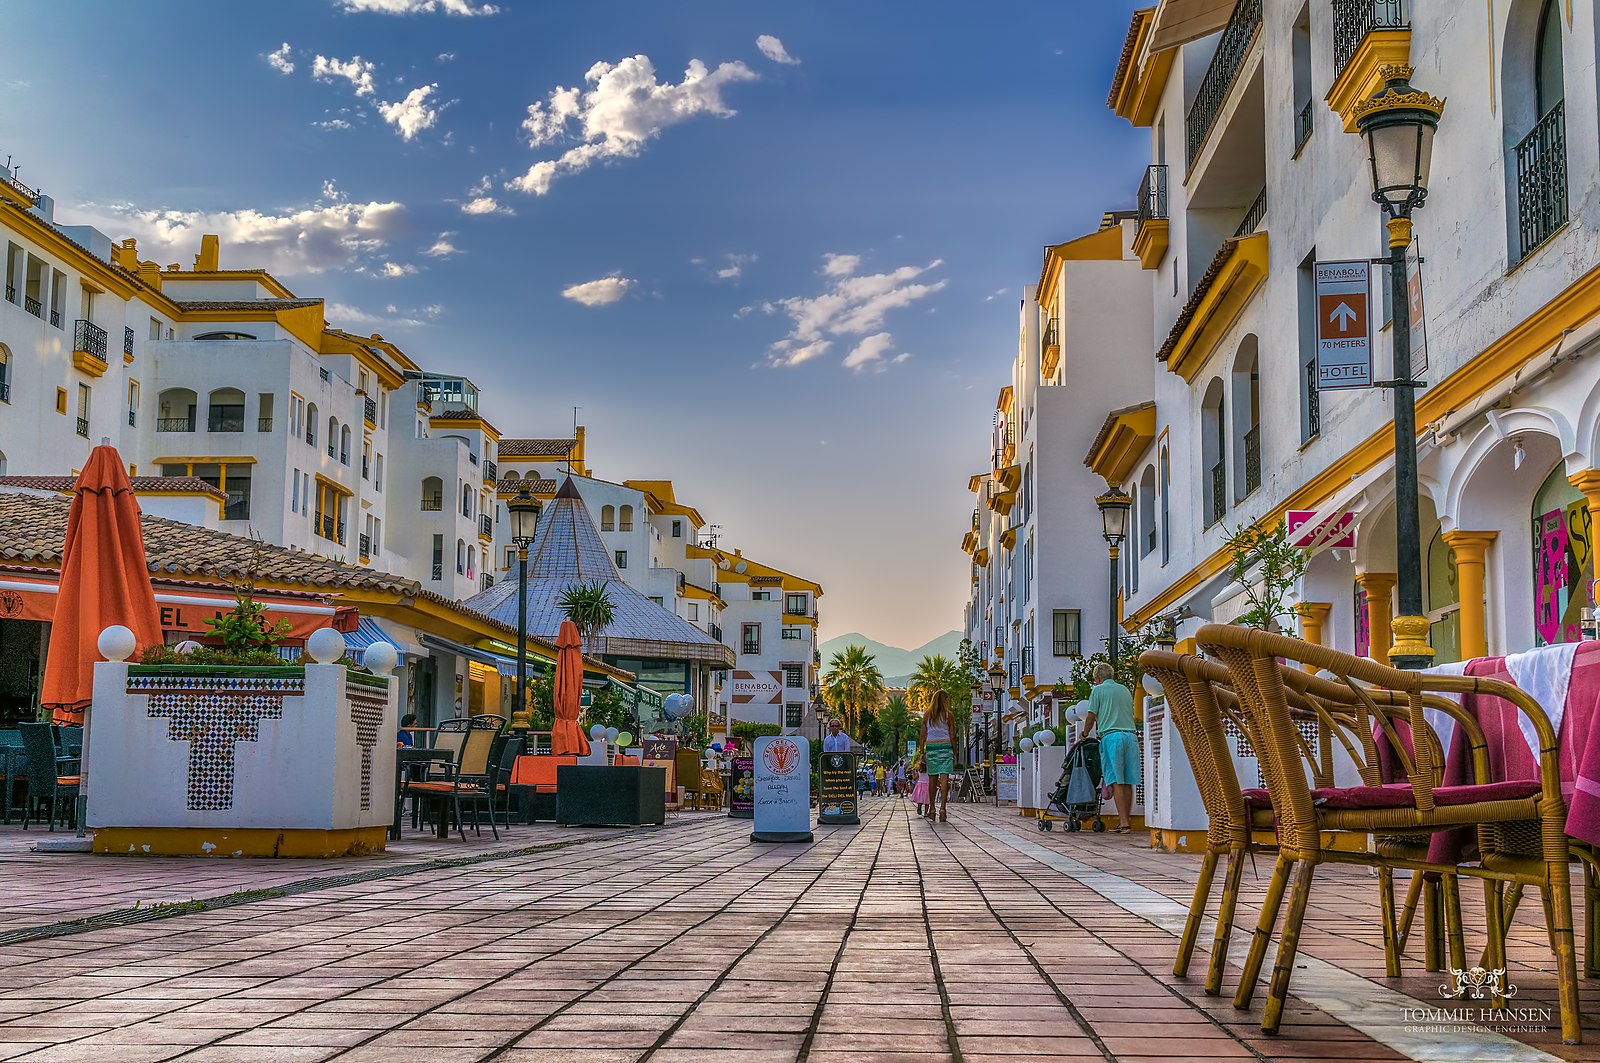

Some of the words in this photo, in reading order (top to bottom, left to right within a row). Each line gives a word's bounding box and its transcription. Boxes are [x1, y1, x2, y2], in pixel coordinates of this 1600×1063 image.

[1318, 268, 1366, 277] BENABOLA
[1322, 341, 1332, 349] 70
[1333, 340, 1366, 348] METERS
[1319, 366, 1367, 378] HOTEL
